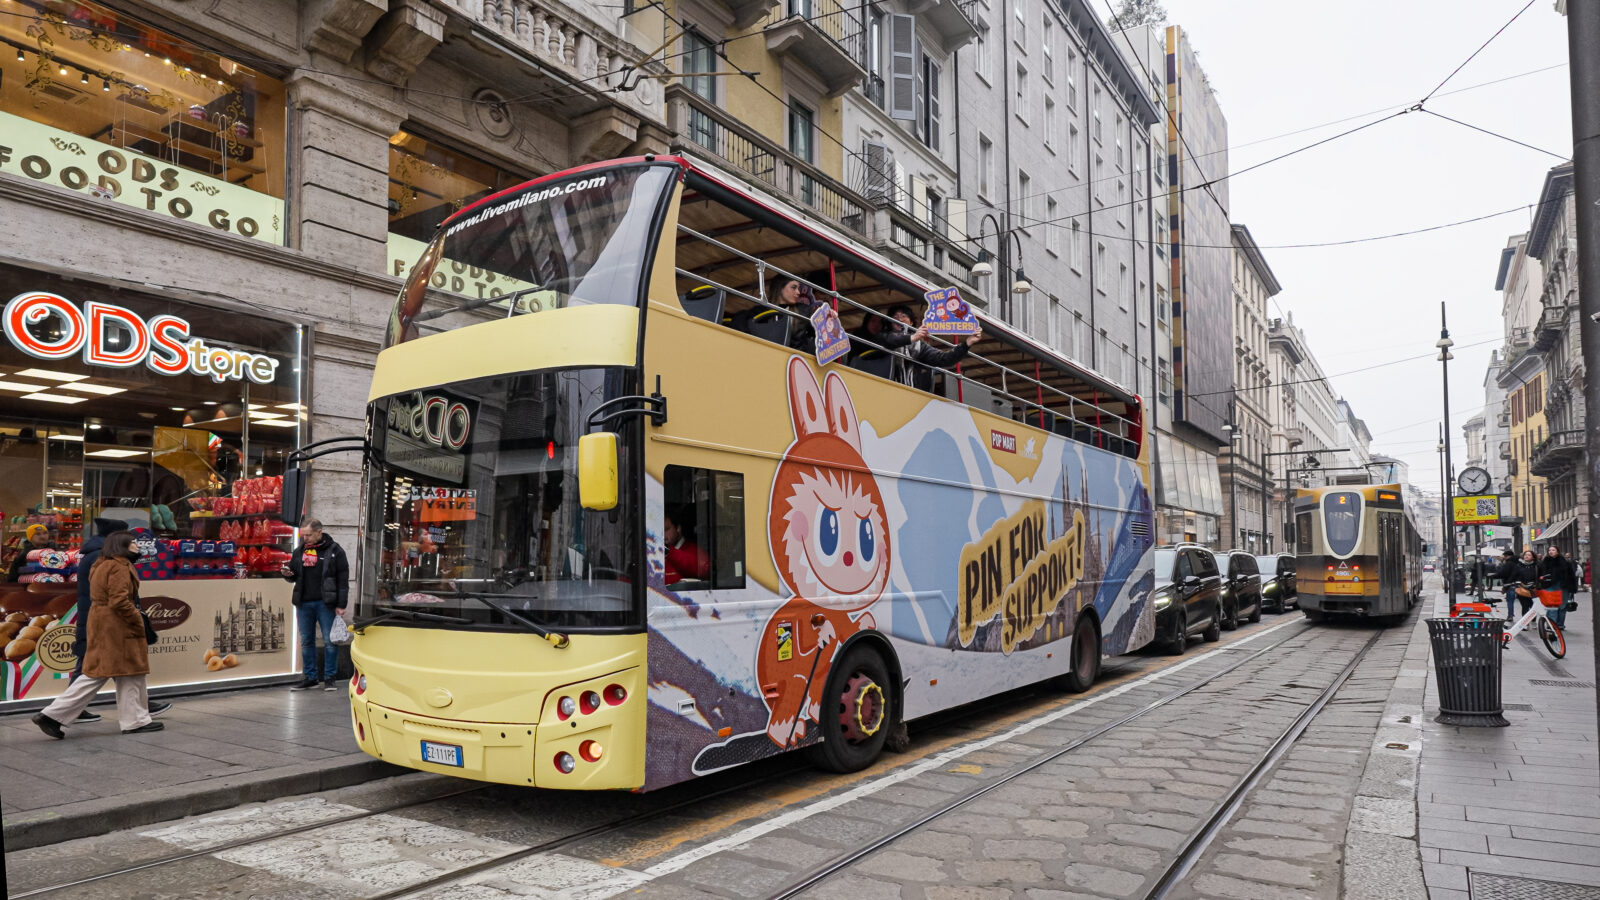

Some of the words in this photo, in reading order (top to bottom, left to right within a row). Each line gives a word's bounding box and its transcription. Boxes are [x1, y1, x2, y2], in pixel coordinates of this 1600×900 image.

[97, 149, 180, 191] ODS
[140, 186, 193, 219] TO
[208, 208, 259, 238] GO
[446, 175, 607, 237] www.livemilano.com
[394, 259, 464, 293] FOD
[451, 260, 496, 283] ODS
[928, 291, 945, 303] THE
[3, 291, 279, 384] ODStore
[992, 432, 1002, 448] POP
[1002, 435, 1016, 451] MART
[1339, 496, 1346, 504] 2
[965, 536, 1001, 629] PIN
[1009, 509, 1046, 584] FOR
[1004, 521, 1082, 645] SUPPORT!
[51, 641, 73, 653] 20
[147, 645, 187, 654] ERPIECE
[161, 635, 200, 645] ITALIAN
